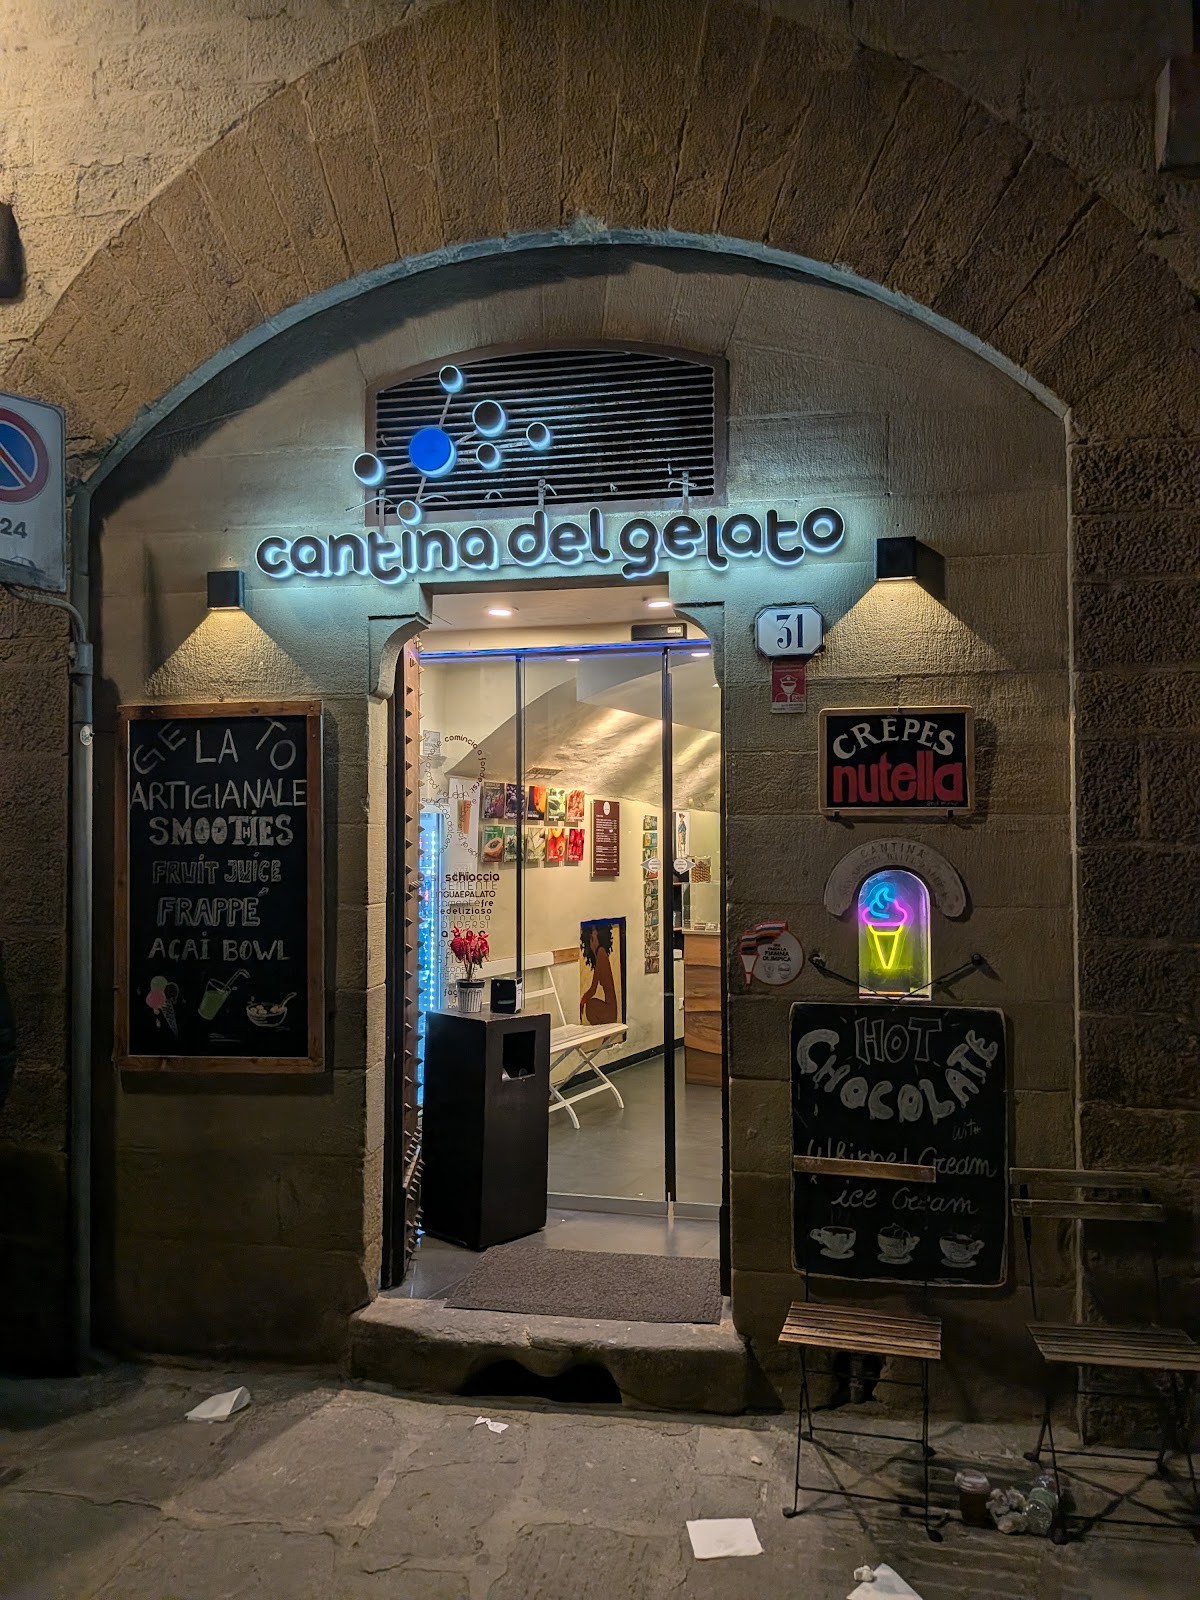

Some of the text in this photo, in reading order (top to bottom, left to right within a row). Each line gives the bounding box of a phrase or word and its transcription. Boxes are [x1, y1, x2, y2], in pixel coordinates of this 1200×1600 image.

[255, 501, 846, 585] cantina del gelato
[776, 613, 804, 650] 31
[133, 717, 297, 775] GELATO
[130, 778, 307, 811] ARTIGIANALE
[832, 751, 964, 804] nutella
[222, 939, 292, 961] BOWL
[855, 1016, 943, 1066] HOT
[796, 1028, 999, 1125] CHOCOLATE
